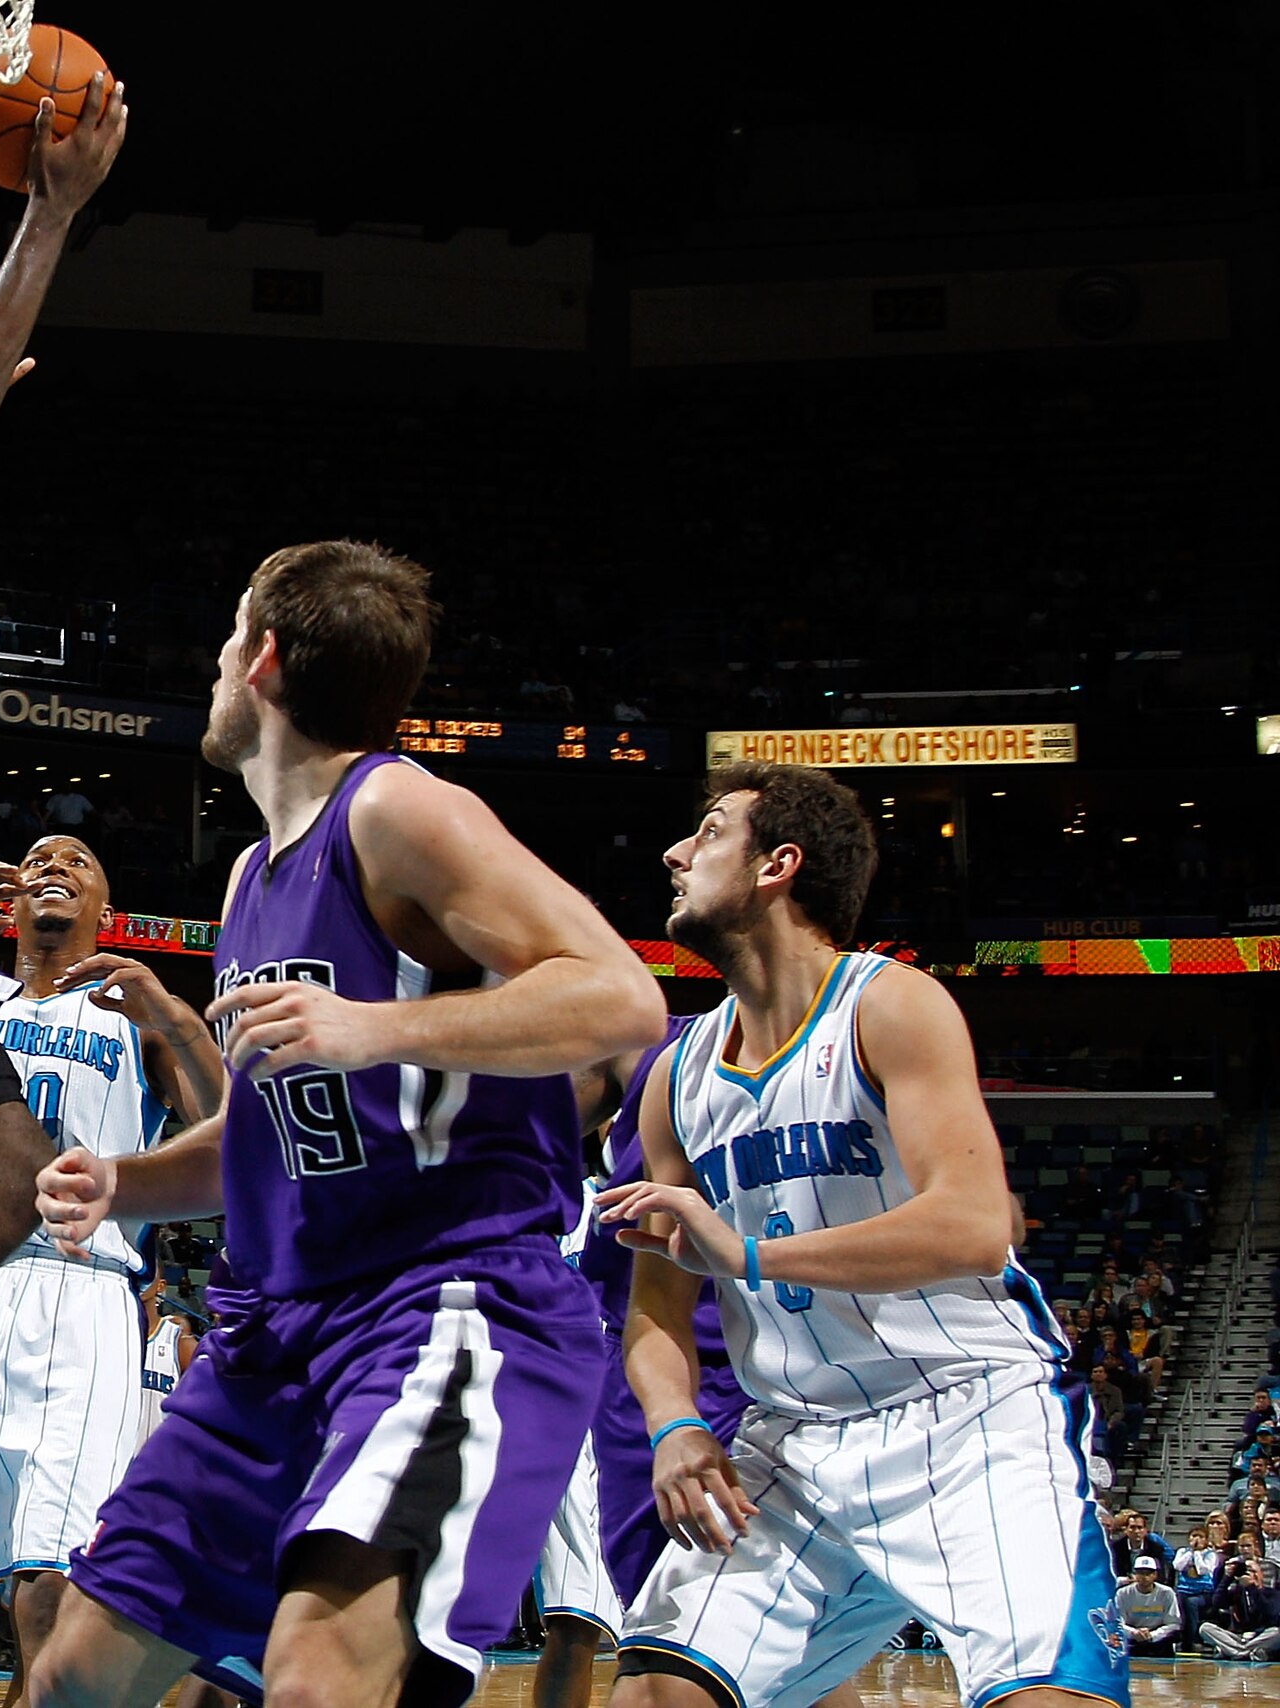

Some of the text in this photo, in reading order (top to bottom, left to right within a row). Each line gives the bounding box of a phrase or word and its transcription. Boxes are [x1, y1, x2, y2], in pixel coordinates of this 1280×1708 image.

[399, 737, 466, 753] THUNDER
[435, 720, 502, 737] ROCKETS
[742, 729, 1035, 765] HORNBECK OFFSHORE
[1043, 918, 1142, 937] HUB CLUB
[3, 1018, 125, 1083] ORLEANS
[254, 1069, 368, 1181] 19
[731, 1119, 885, 1191] ORLEANS
